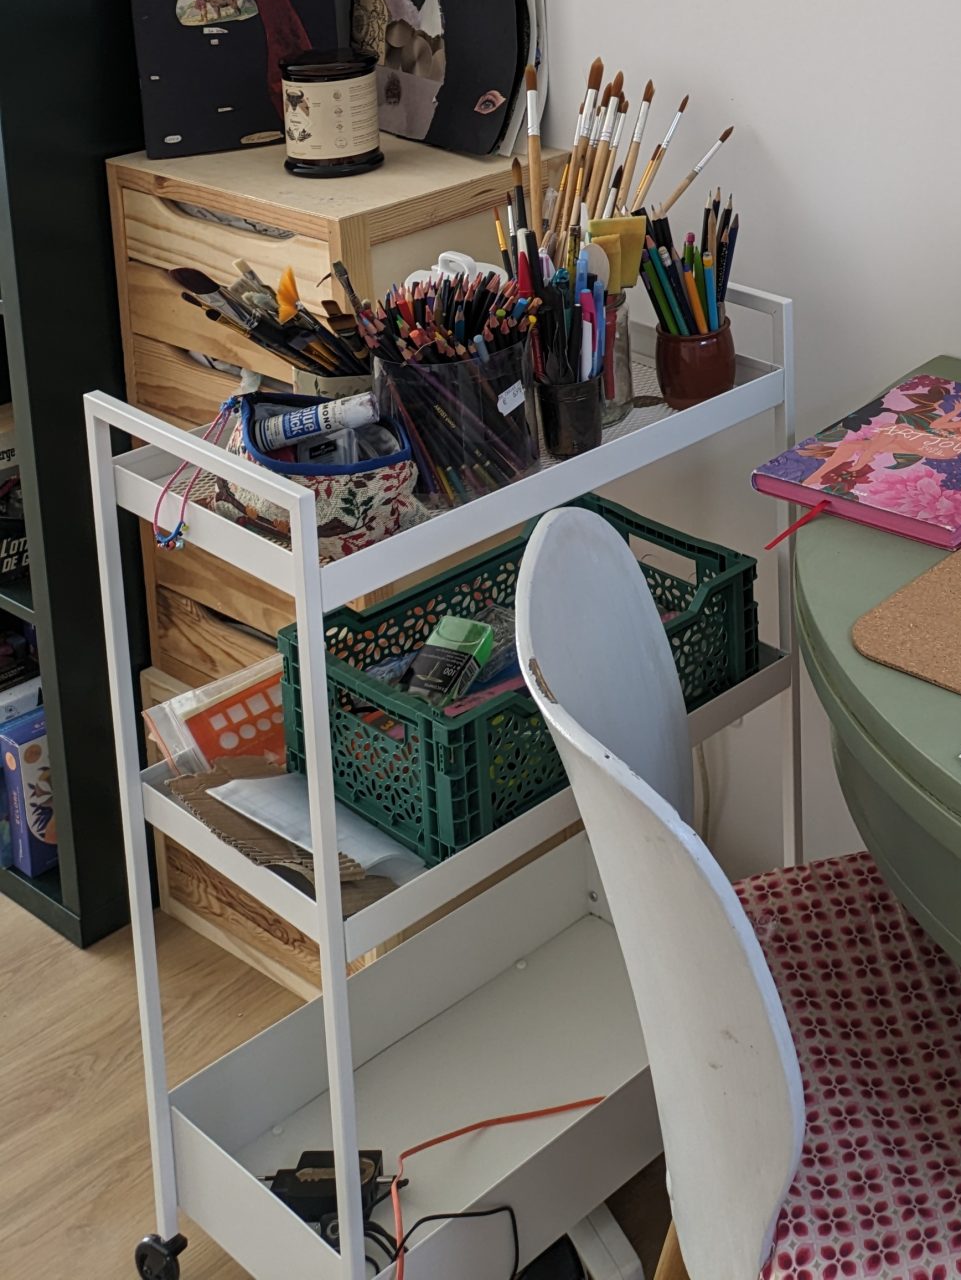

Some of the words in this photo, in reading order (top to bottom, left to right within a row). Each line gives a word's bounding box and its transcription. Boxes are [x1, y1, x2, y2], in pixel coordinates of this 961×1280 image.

[320, 403, 332, 430] MONO
[876, 425, 932, 441] ART
[0, 537, 28, 558] L'OT
[1, 555, 18, 573] DE
